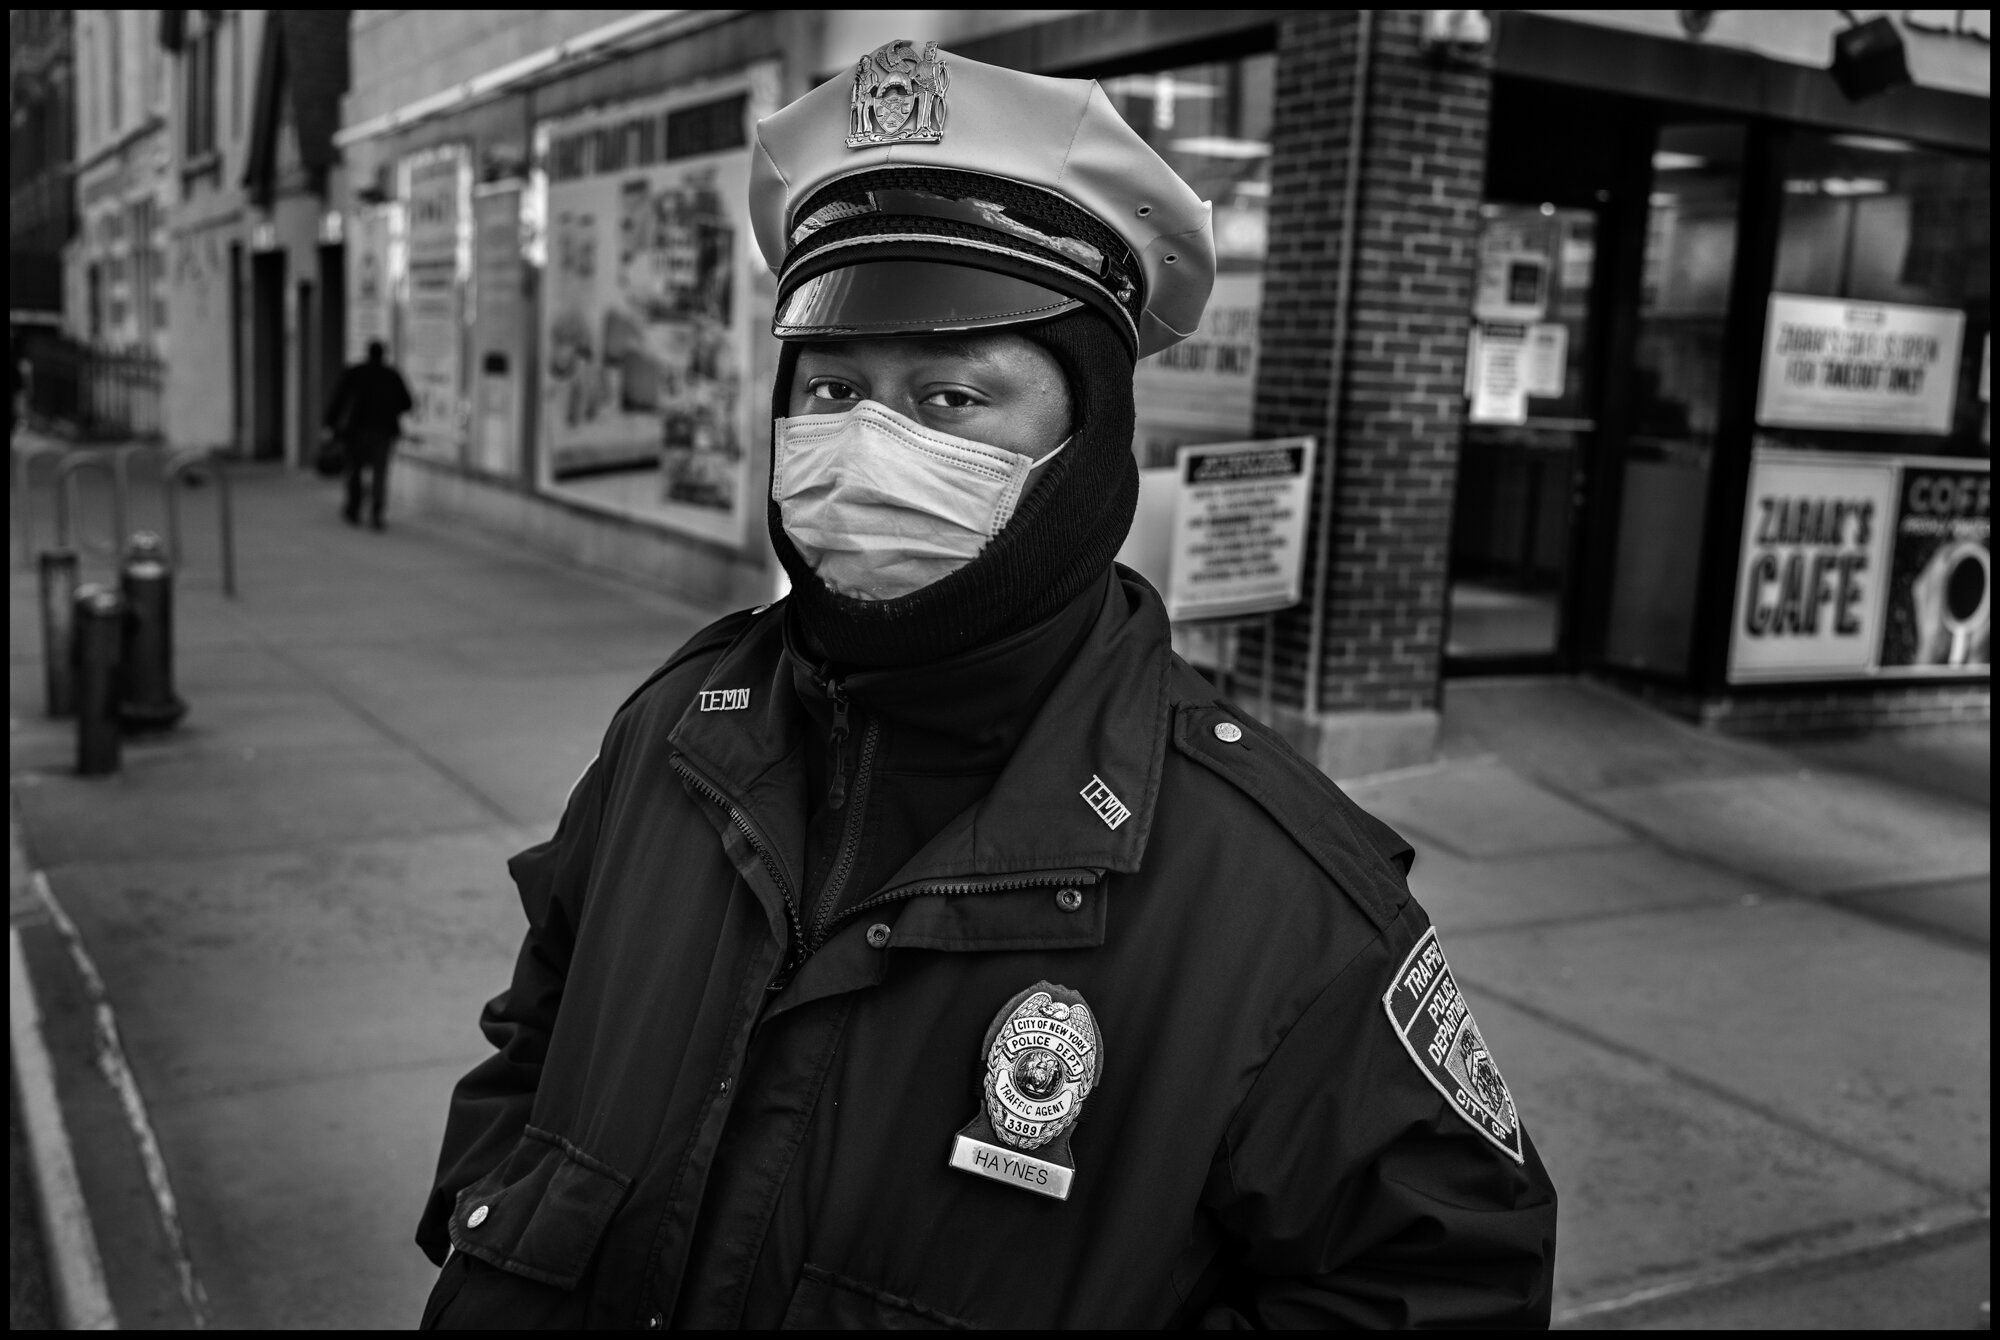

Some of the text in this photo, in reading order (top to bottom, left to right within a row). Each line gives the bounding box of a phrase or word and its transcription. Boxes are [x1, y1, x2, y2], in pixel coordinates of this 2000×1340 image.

[1757, 497, 1875, 545] ZABAR'S
[1746, 554, 1868, 637] CAFE
[1011, 1035, 1081, 1071] POLICE DEPT.
[1017, 1020, 1087, 1052] CITY OF NEW YORK
[1000, 1083, 1066, 1117] TRAFFIC AGENT
[1456, 1088, 1488, 1125] CITY
[1491, 1121, 1506, 1140] OF
[1007, 1118, 1038, 1136] 3389
[975, 1150, 1049, 1185] HAYNES
